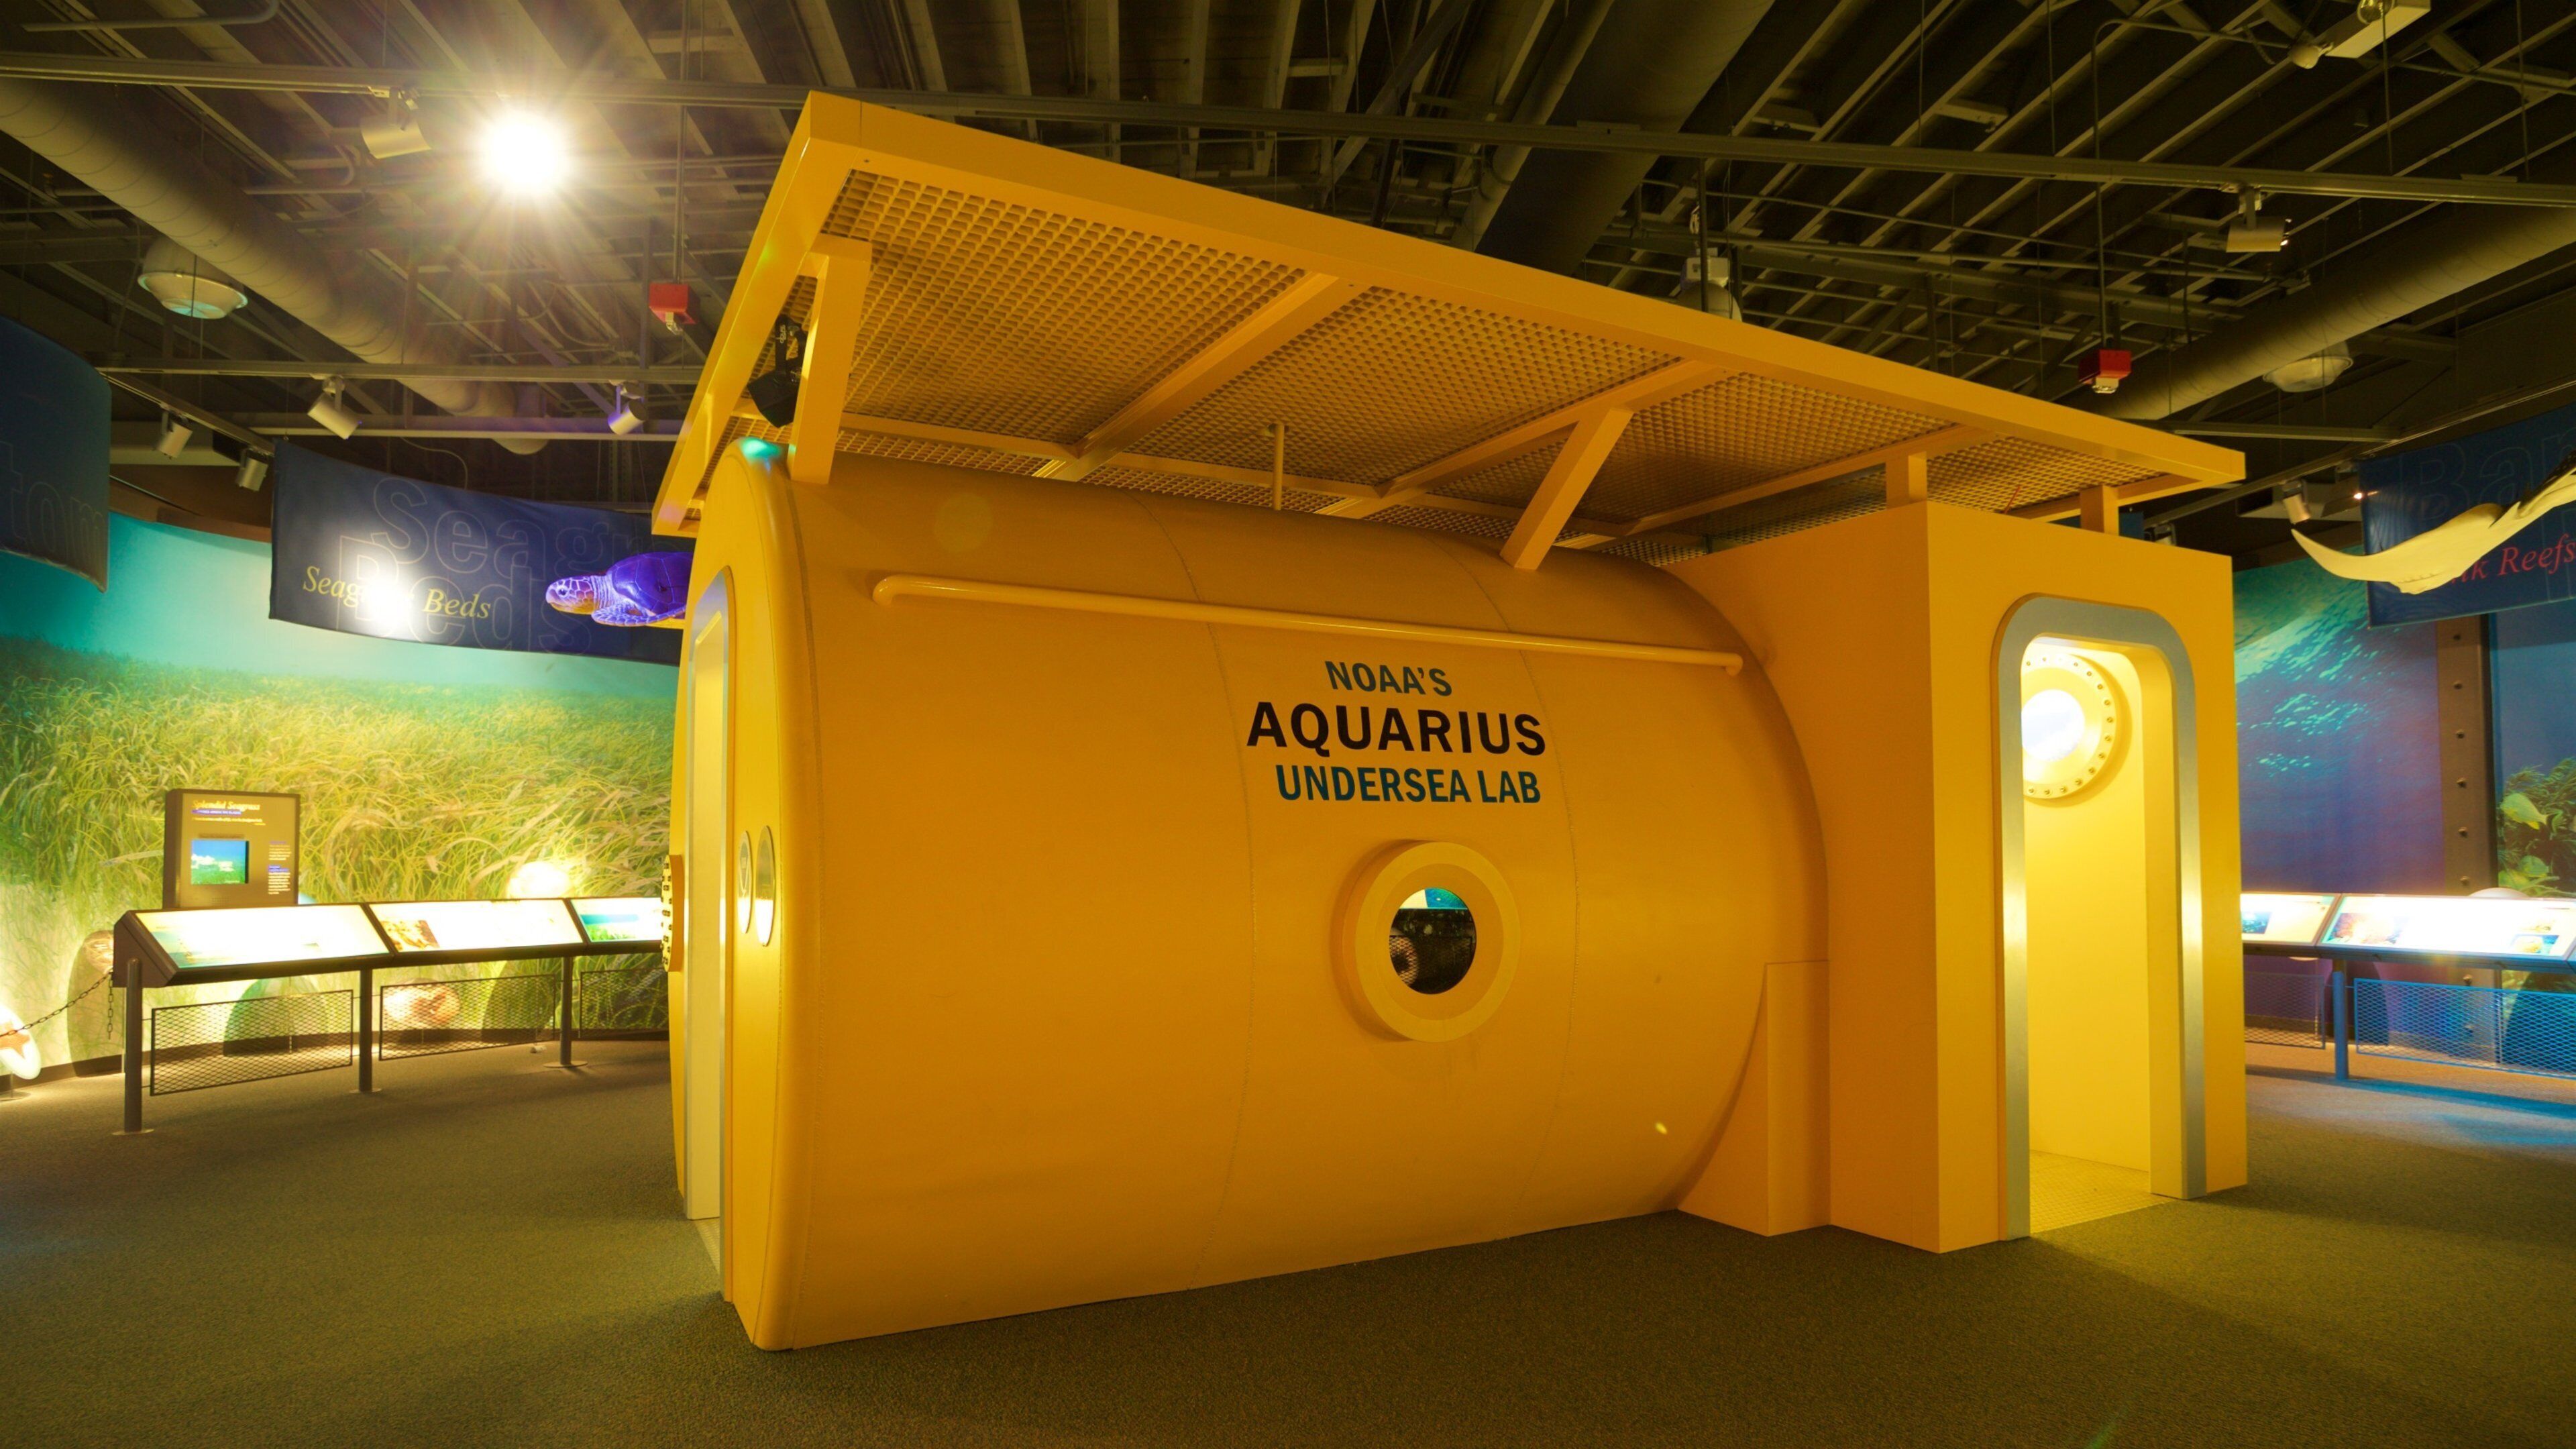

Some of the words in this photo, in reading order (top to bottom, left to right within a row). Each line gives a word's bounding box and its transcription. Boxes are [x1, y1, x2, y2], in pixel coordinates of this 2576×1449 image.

[2498, 533, 2576, 576] Reefs
[422, 588, 491, 619] Beds
[1325, 661, 1452, 697] NOAA'S
[1246, 702, 1546, 758] AQUARIUS
[1276, 765, 1472, 803] UNDERSEA
[1477, 770, 1541, 804] LAB
